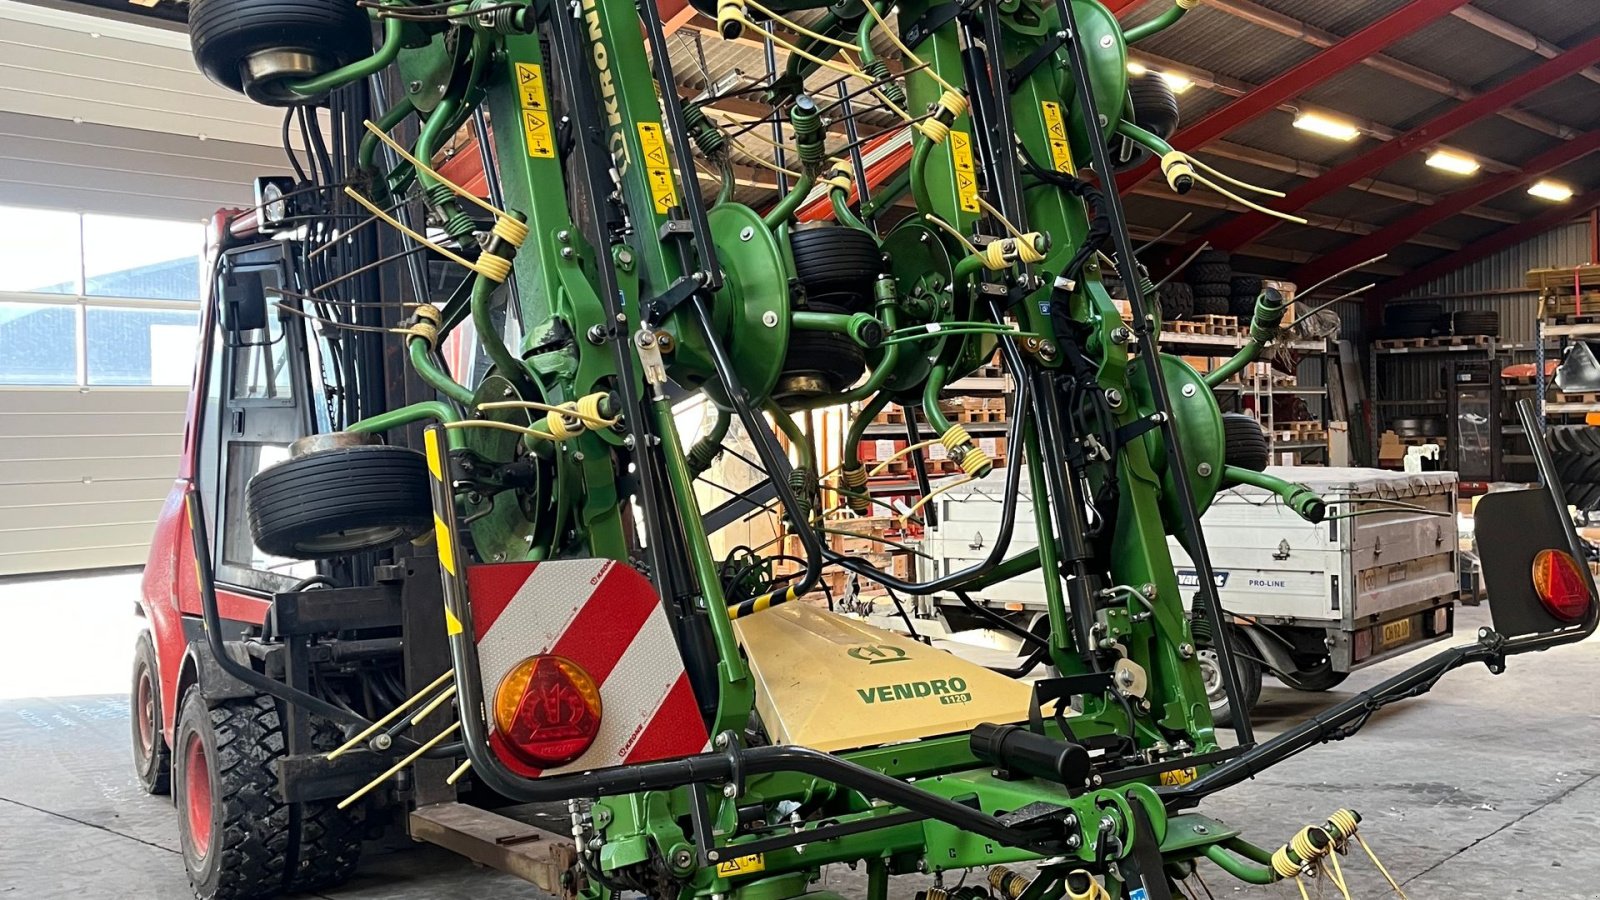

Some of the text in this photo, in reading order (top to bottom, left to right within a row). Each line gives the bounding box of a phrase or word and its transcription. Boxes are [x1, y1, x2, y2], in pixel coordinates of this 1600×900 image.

[1177, 574, 1225, 586] vart
[1248, 579, 1286, 588] PRO-LINE
[856, 677, 967, 704] VENDRO
[944, 694, 967, 704] 1120
[625, 723, 643, 751] KRONE
